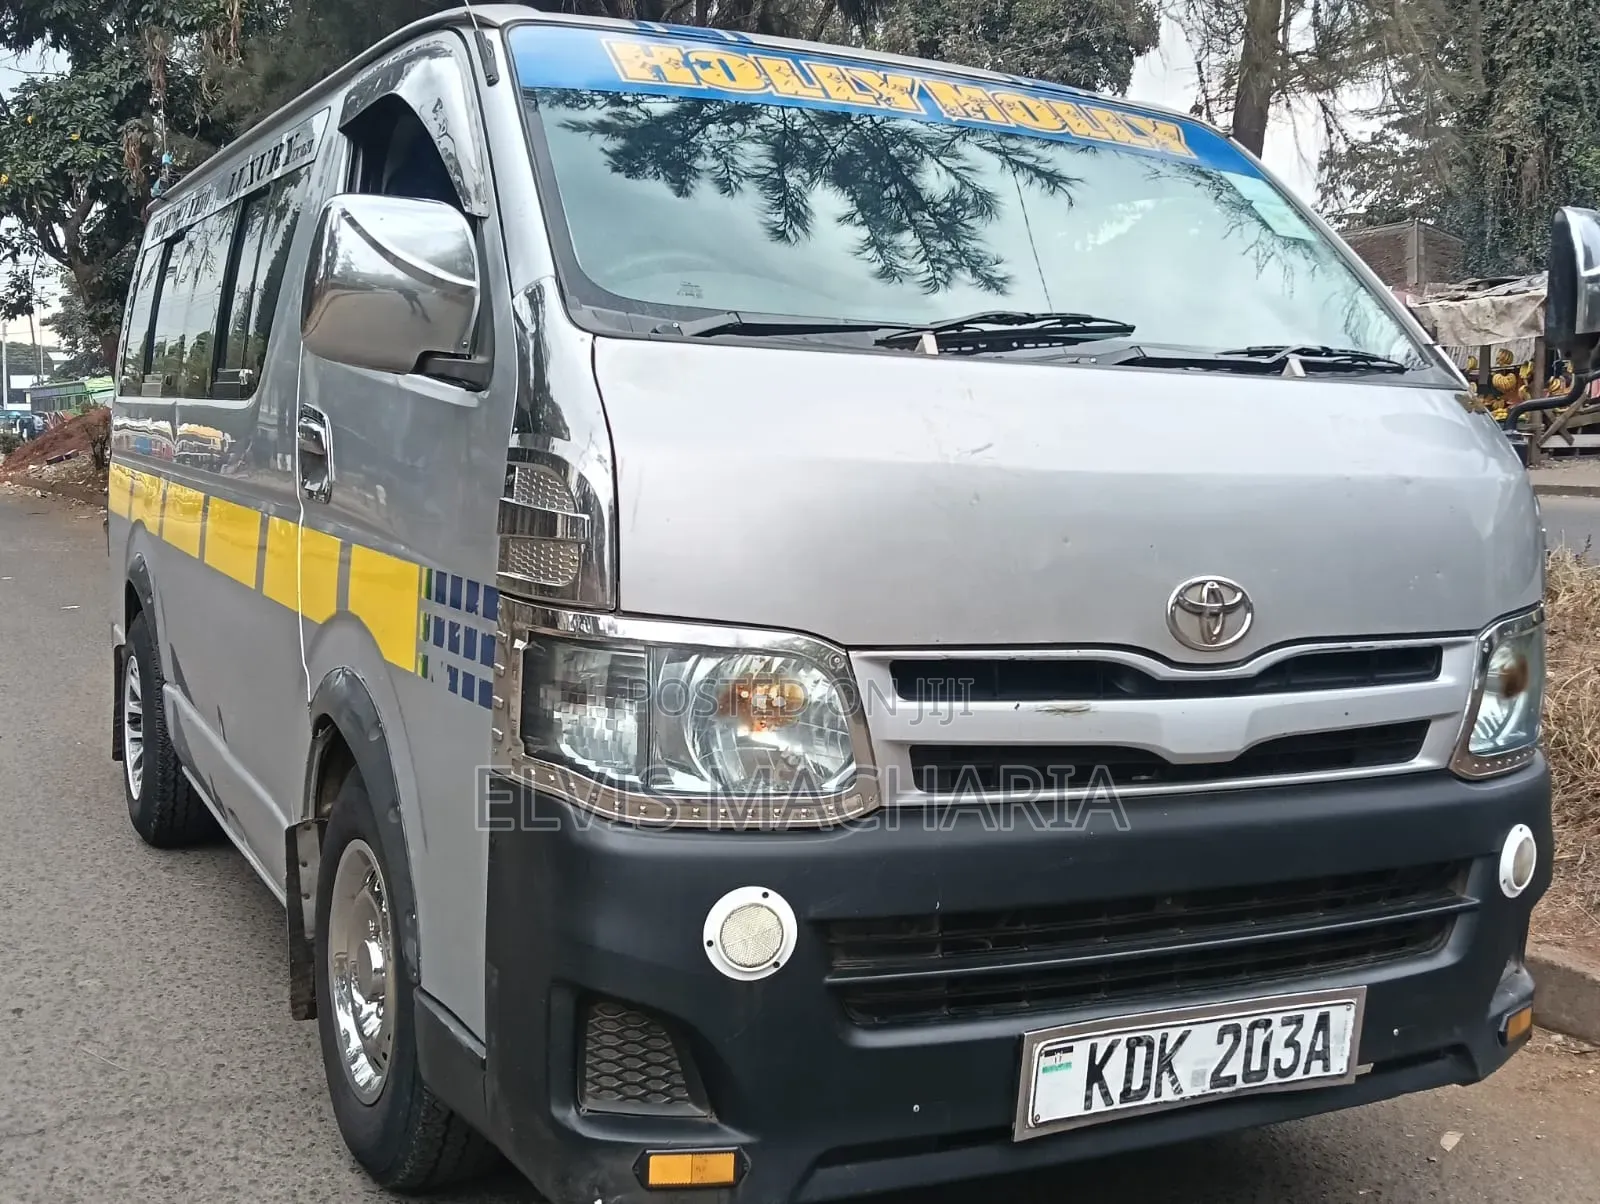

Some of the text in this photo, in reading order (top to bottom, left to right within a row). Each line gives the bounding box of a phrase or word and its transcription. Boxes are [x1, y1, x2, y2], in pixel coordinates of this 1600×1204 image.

[604, 40, 1195, 158] HOLLY MOLLY
[1083, 1010, 1332, 1111] KDK 203A
